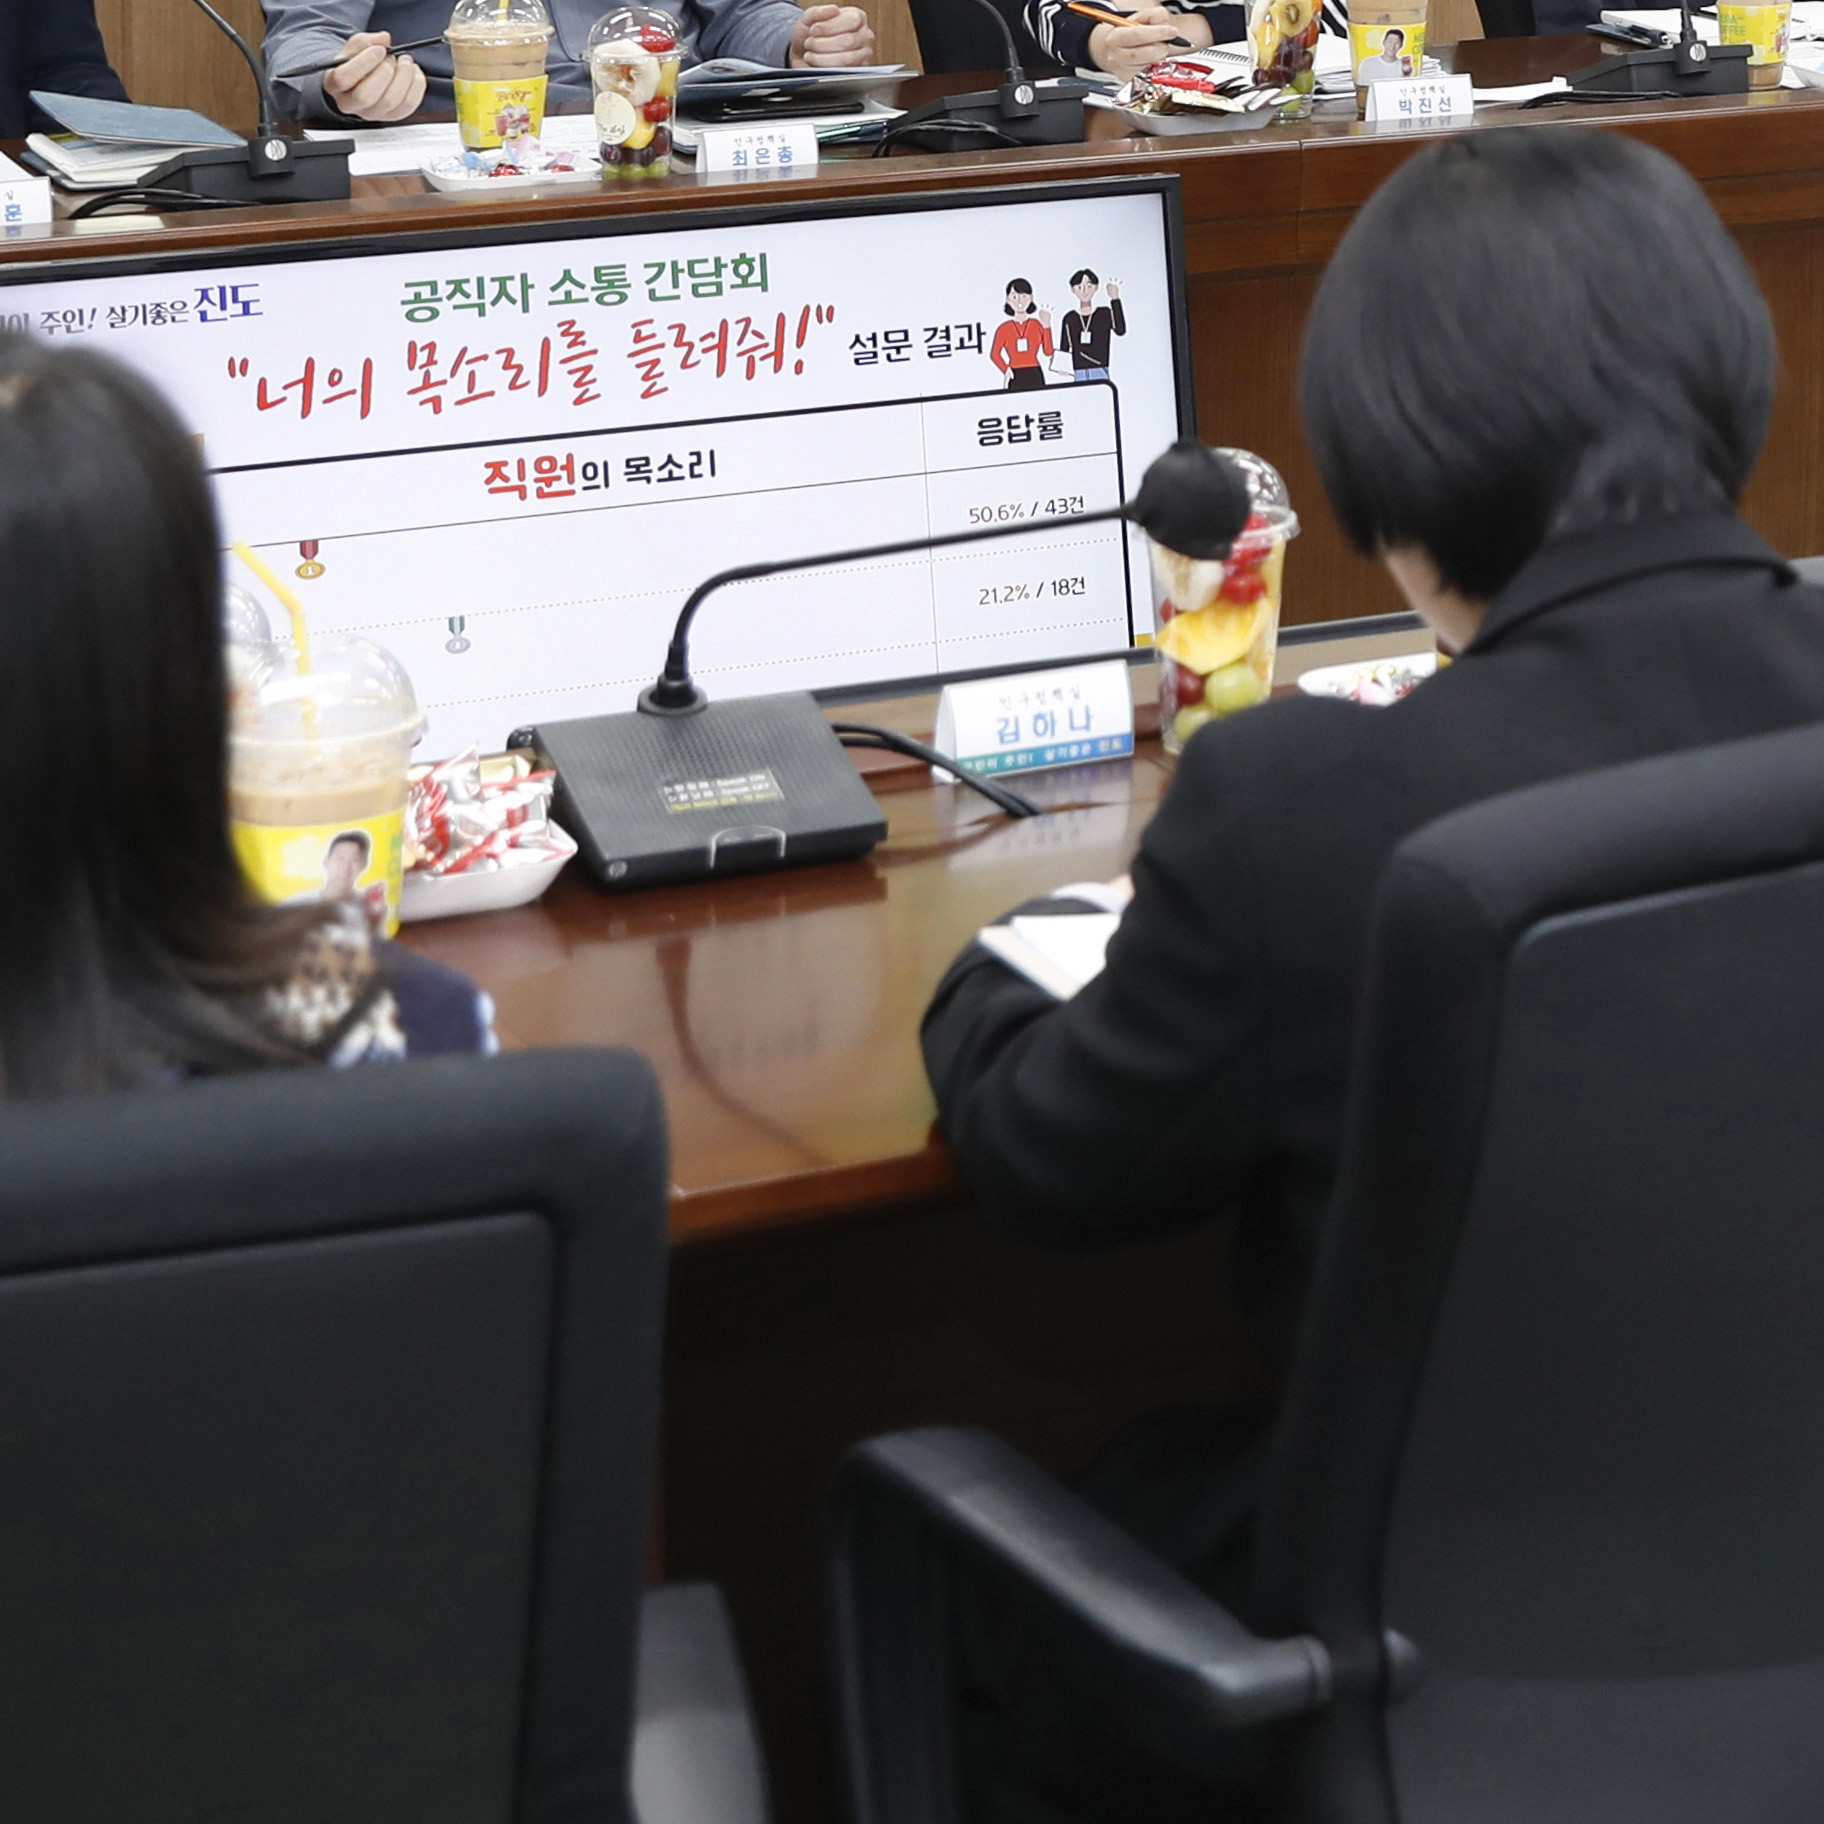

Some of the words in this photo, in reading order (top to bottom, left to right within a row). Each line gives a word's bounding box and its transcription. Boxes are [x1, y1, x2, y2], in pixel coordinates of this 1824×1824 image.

[39, 306, 97, 335] 주인!
[105, 299, 190, 330] 살기좋은
[193, 282, 264, 323] 진도
[400, 273, 535, 324] 공직자
[547, 262, 633, 309] 소통
[643, 251, 770, 302] 간담회
[406, 318, 602, 416] 목소리를
[847, 327, 914, 367] 설문
[921, 321, 988, 358] 결과
[483, 452, 611, 502] 직원의
[622, 448, 717, 486] 목소리
[976, 410, 1064, 447] 응답률
[968, 502, 1025, 525] 50.6%
[1044, 494, 1085, 516] 43건
[978, 583, 1030, 606] 21.2%
[1050, 576, 1086, 597] 18건
[996, 704, 1093, 745] 김하나
